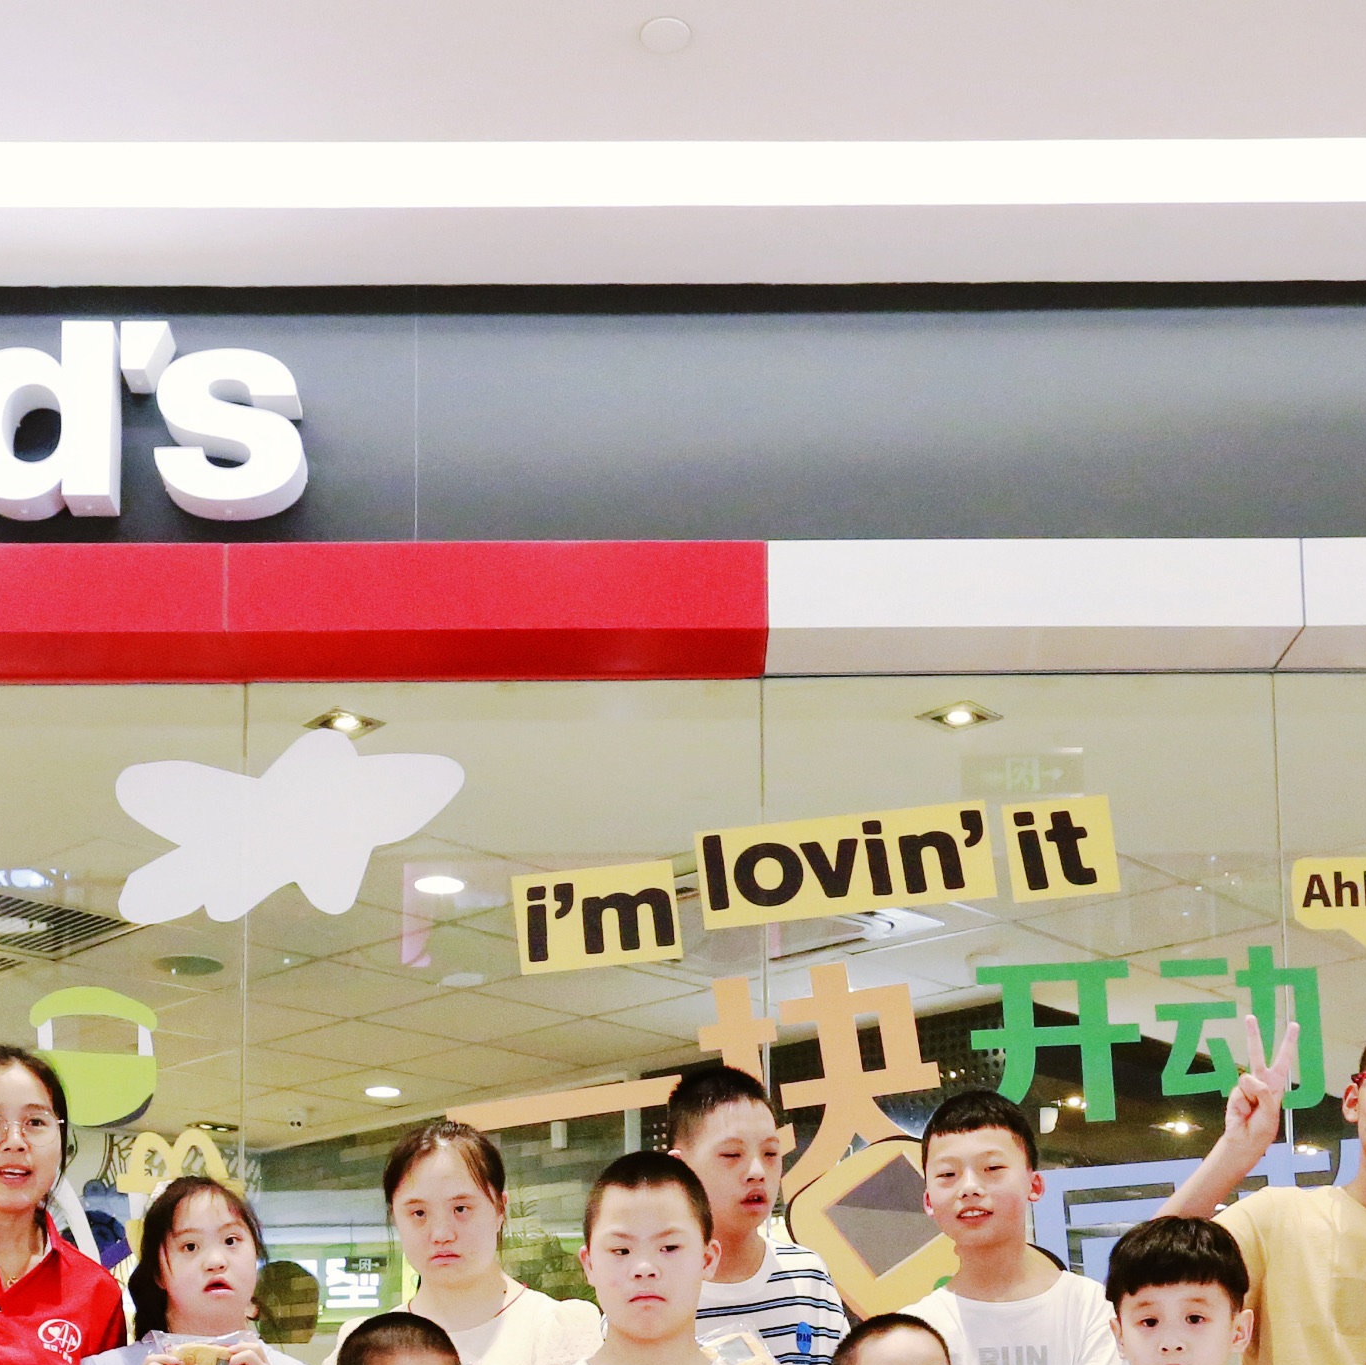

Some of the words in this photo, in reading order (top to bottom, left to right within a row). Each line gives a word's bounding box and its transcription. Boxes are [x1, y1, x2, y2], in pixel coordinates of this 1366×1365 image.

[525, 879, 677, 964] i'm
[704, 809, 984, 913] lovin'
[1016, 807, 1098, 893] it
